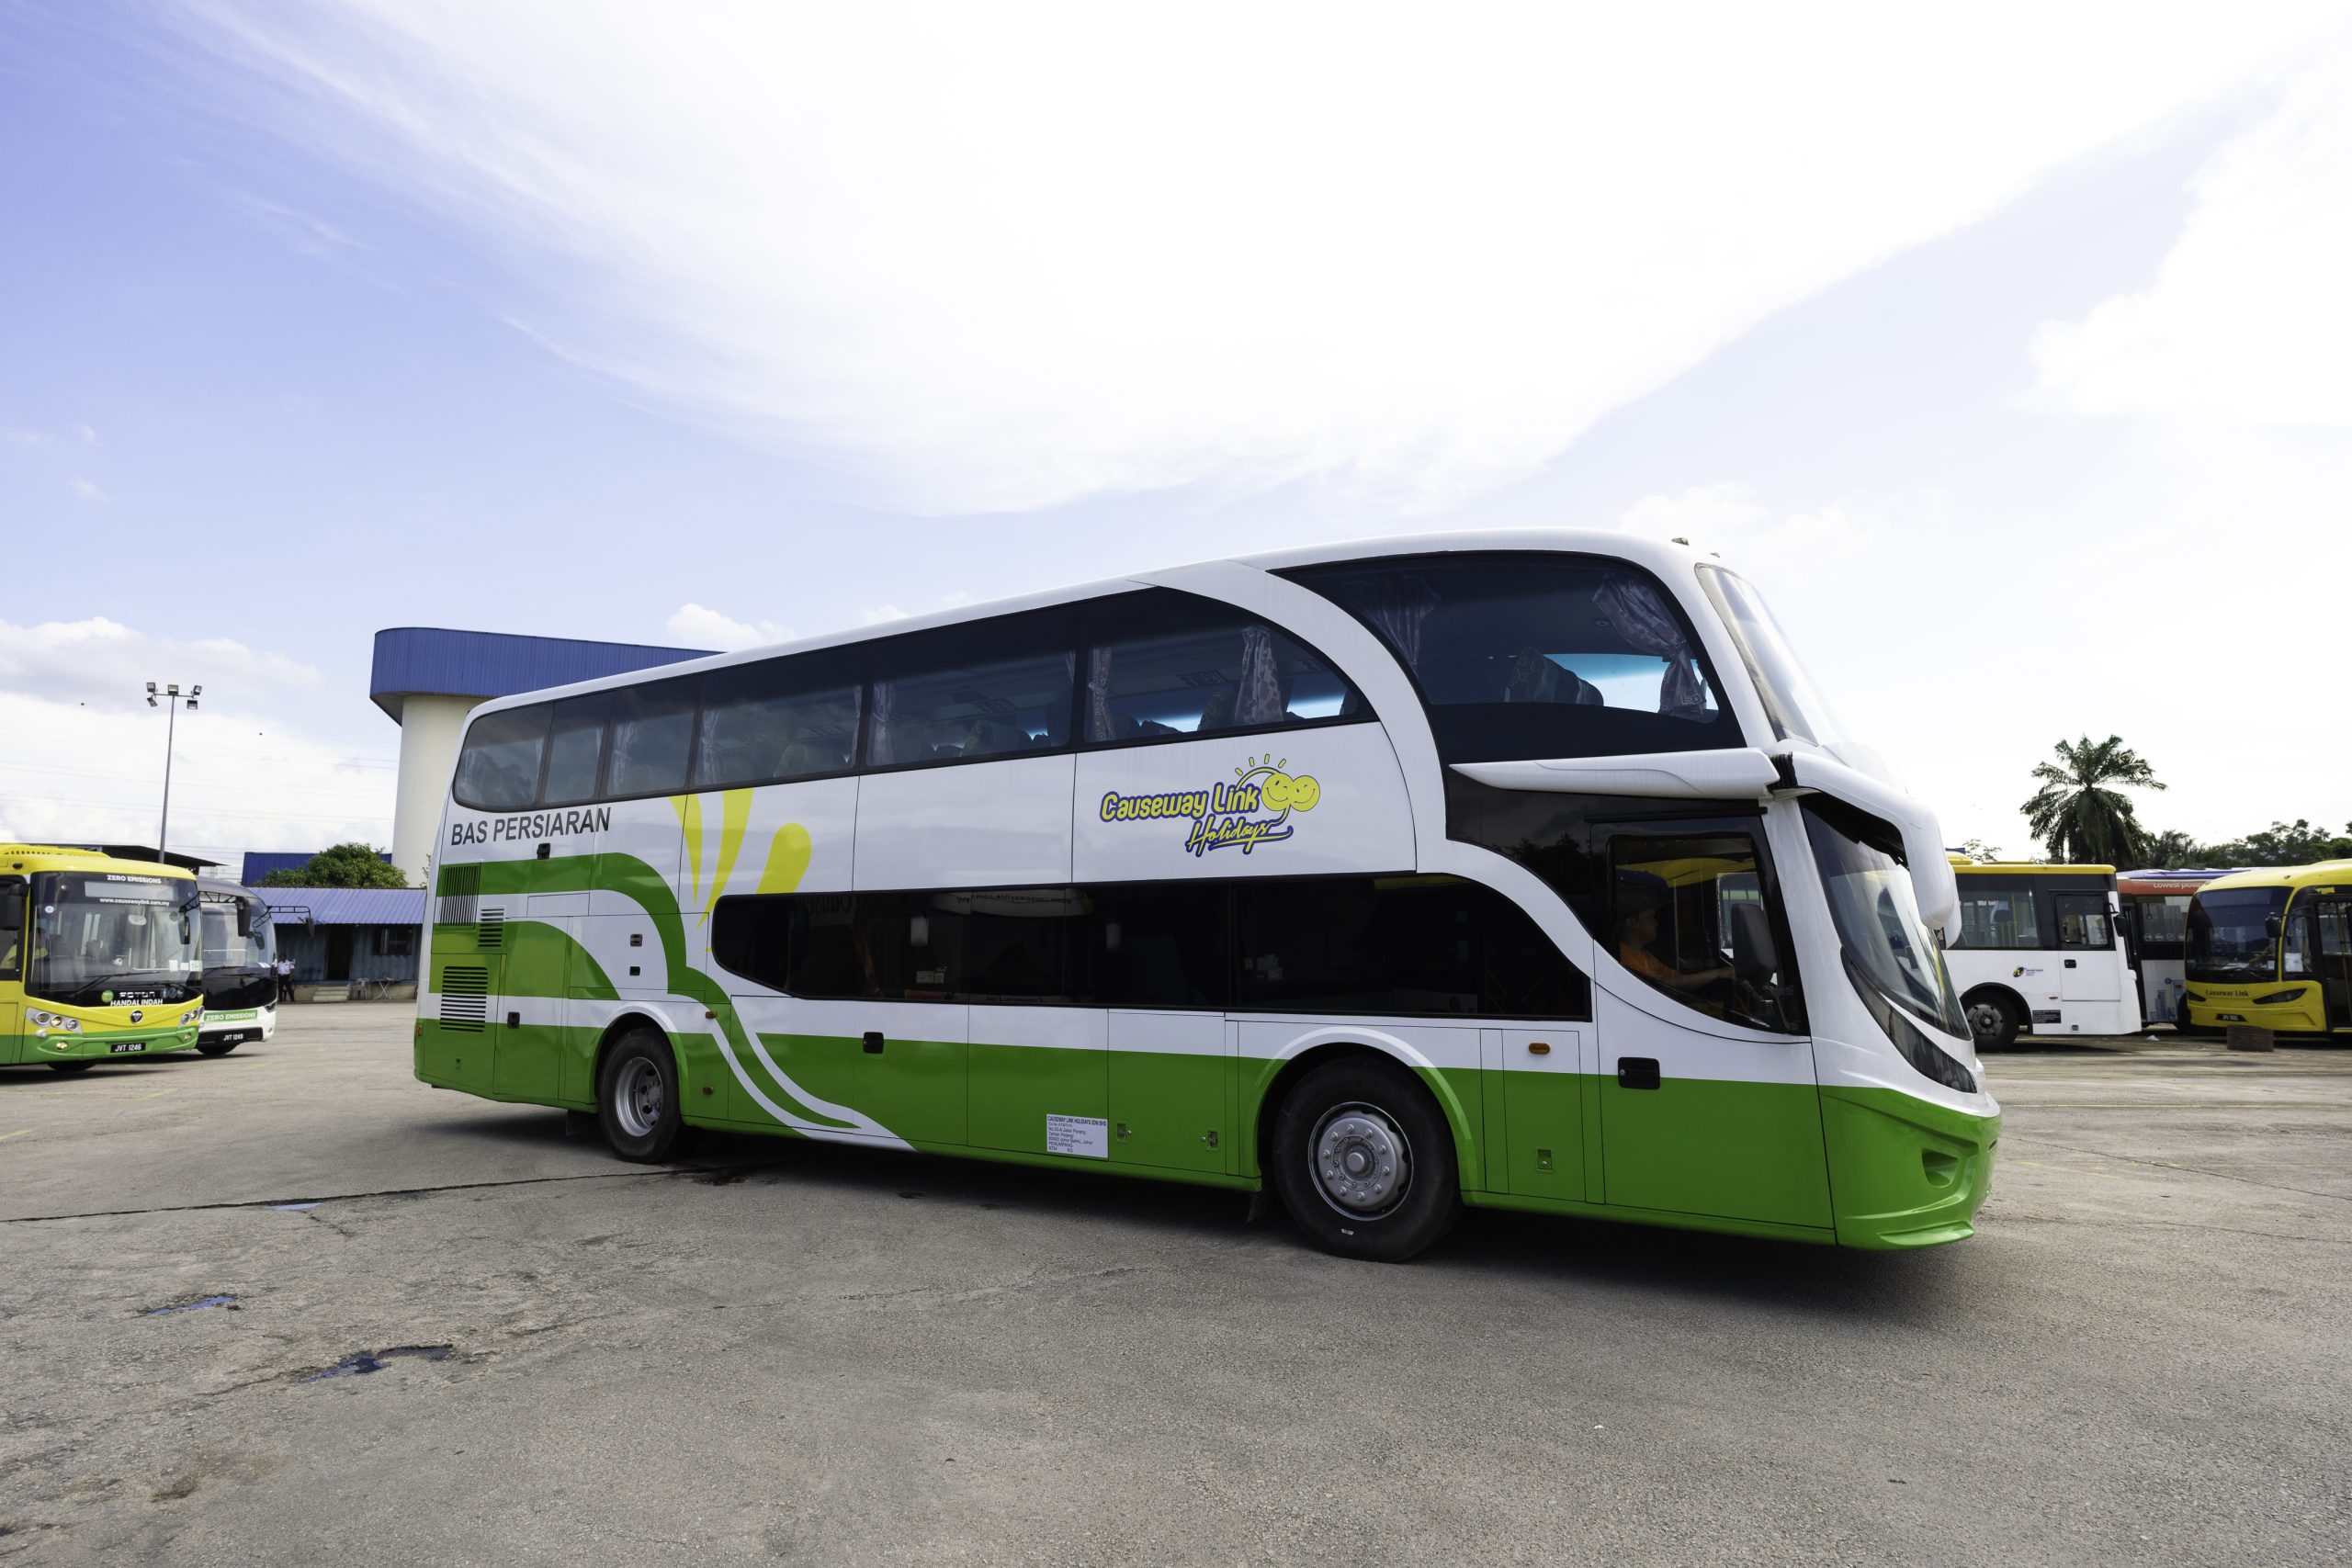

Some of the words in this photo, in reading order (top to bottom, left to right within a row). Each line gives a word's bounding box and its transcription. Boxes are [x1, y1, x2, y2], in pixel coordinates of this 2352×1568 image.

[1100, 790, 1209, 822] Causeway
[1211, 782, 1261, 814] Link
[451, 820, 488, 846] BAS
[493, 807, 612, 842] PERSIARAN
[1185, 814, 1272, 857] Holidays
[127, 875, 162, 884] EMISSIONS
[225, 1012, 256, 1021] EMISSIONS
